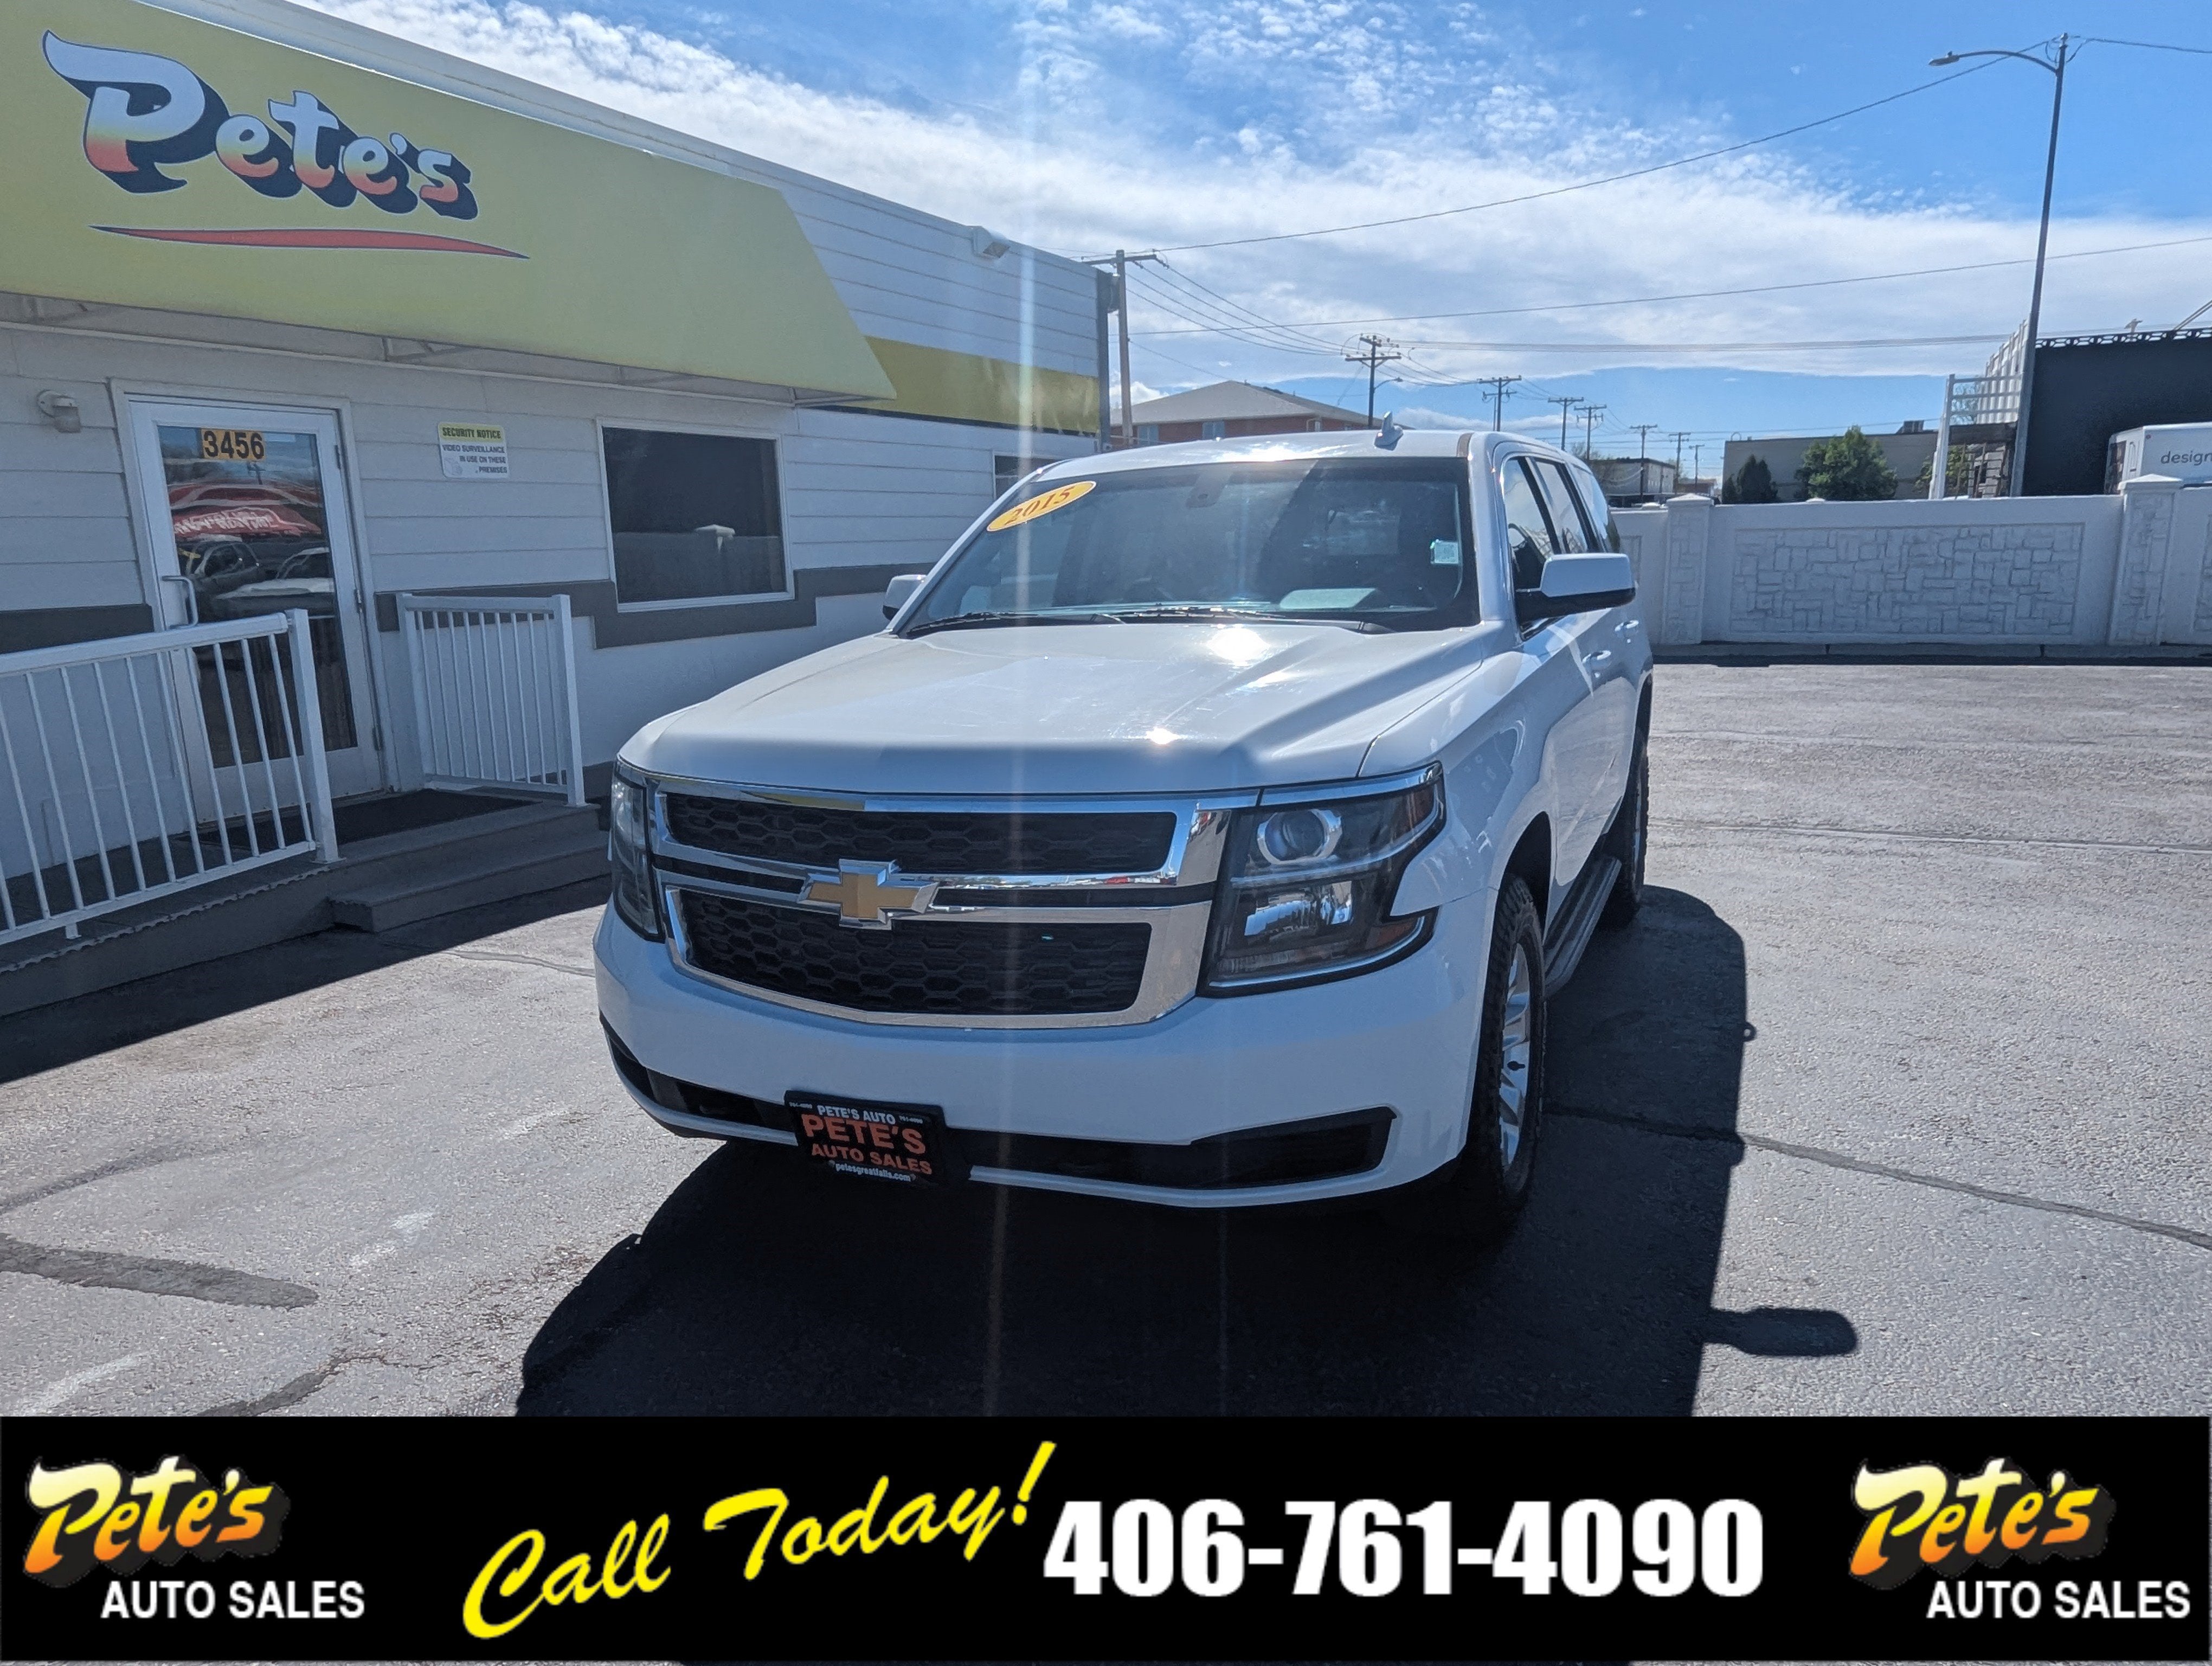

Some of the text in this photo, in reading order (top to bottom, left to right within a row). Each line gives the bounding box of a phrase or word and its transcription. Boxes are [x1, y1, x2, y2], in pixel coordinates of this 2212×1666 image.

[43, 29, 479, 220] Pete's
[204, 431, 264, 459] 3456
[442, 427, 501, 439] SECURITY NOTICE
[1004, 486, 1075, 526] 2015
[817, 1105, 859, 1120] PETE'S
[863, 1110, 895, 1125] AUTO
[801, 1113, 925, 1154] PETE'S
[812, 1143, 932, 1175] AUTO SALES
